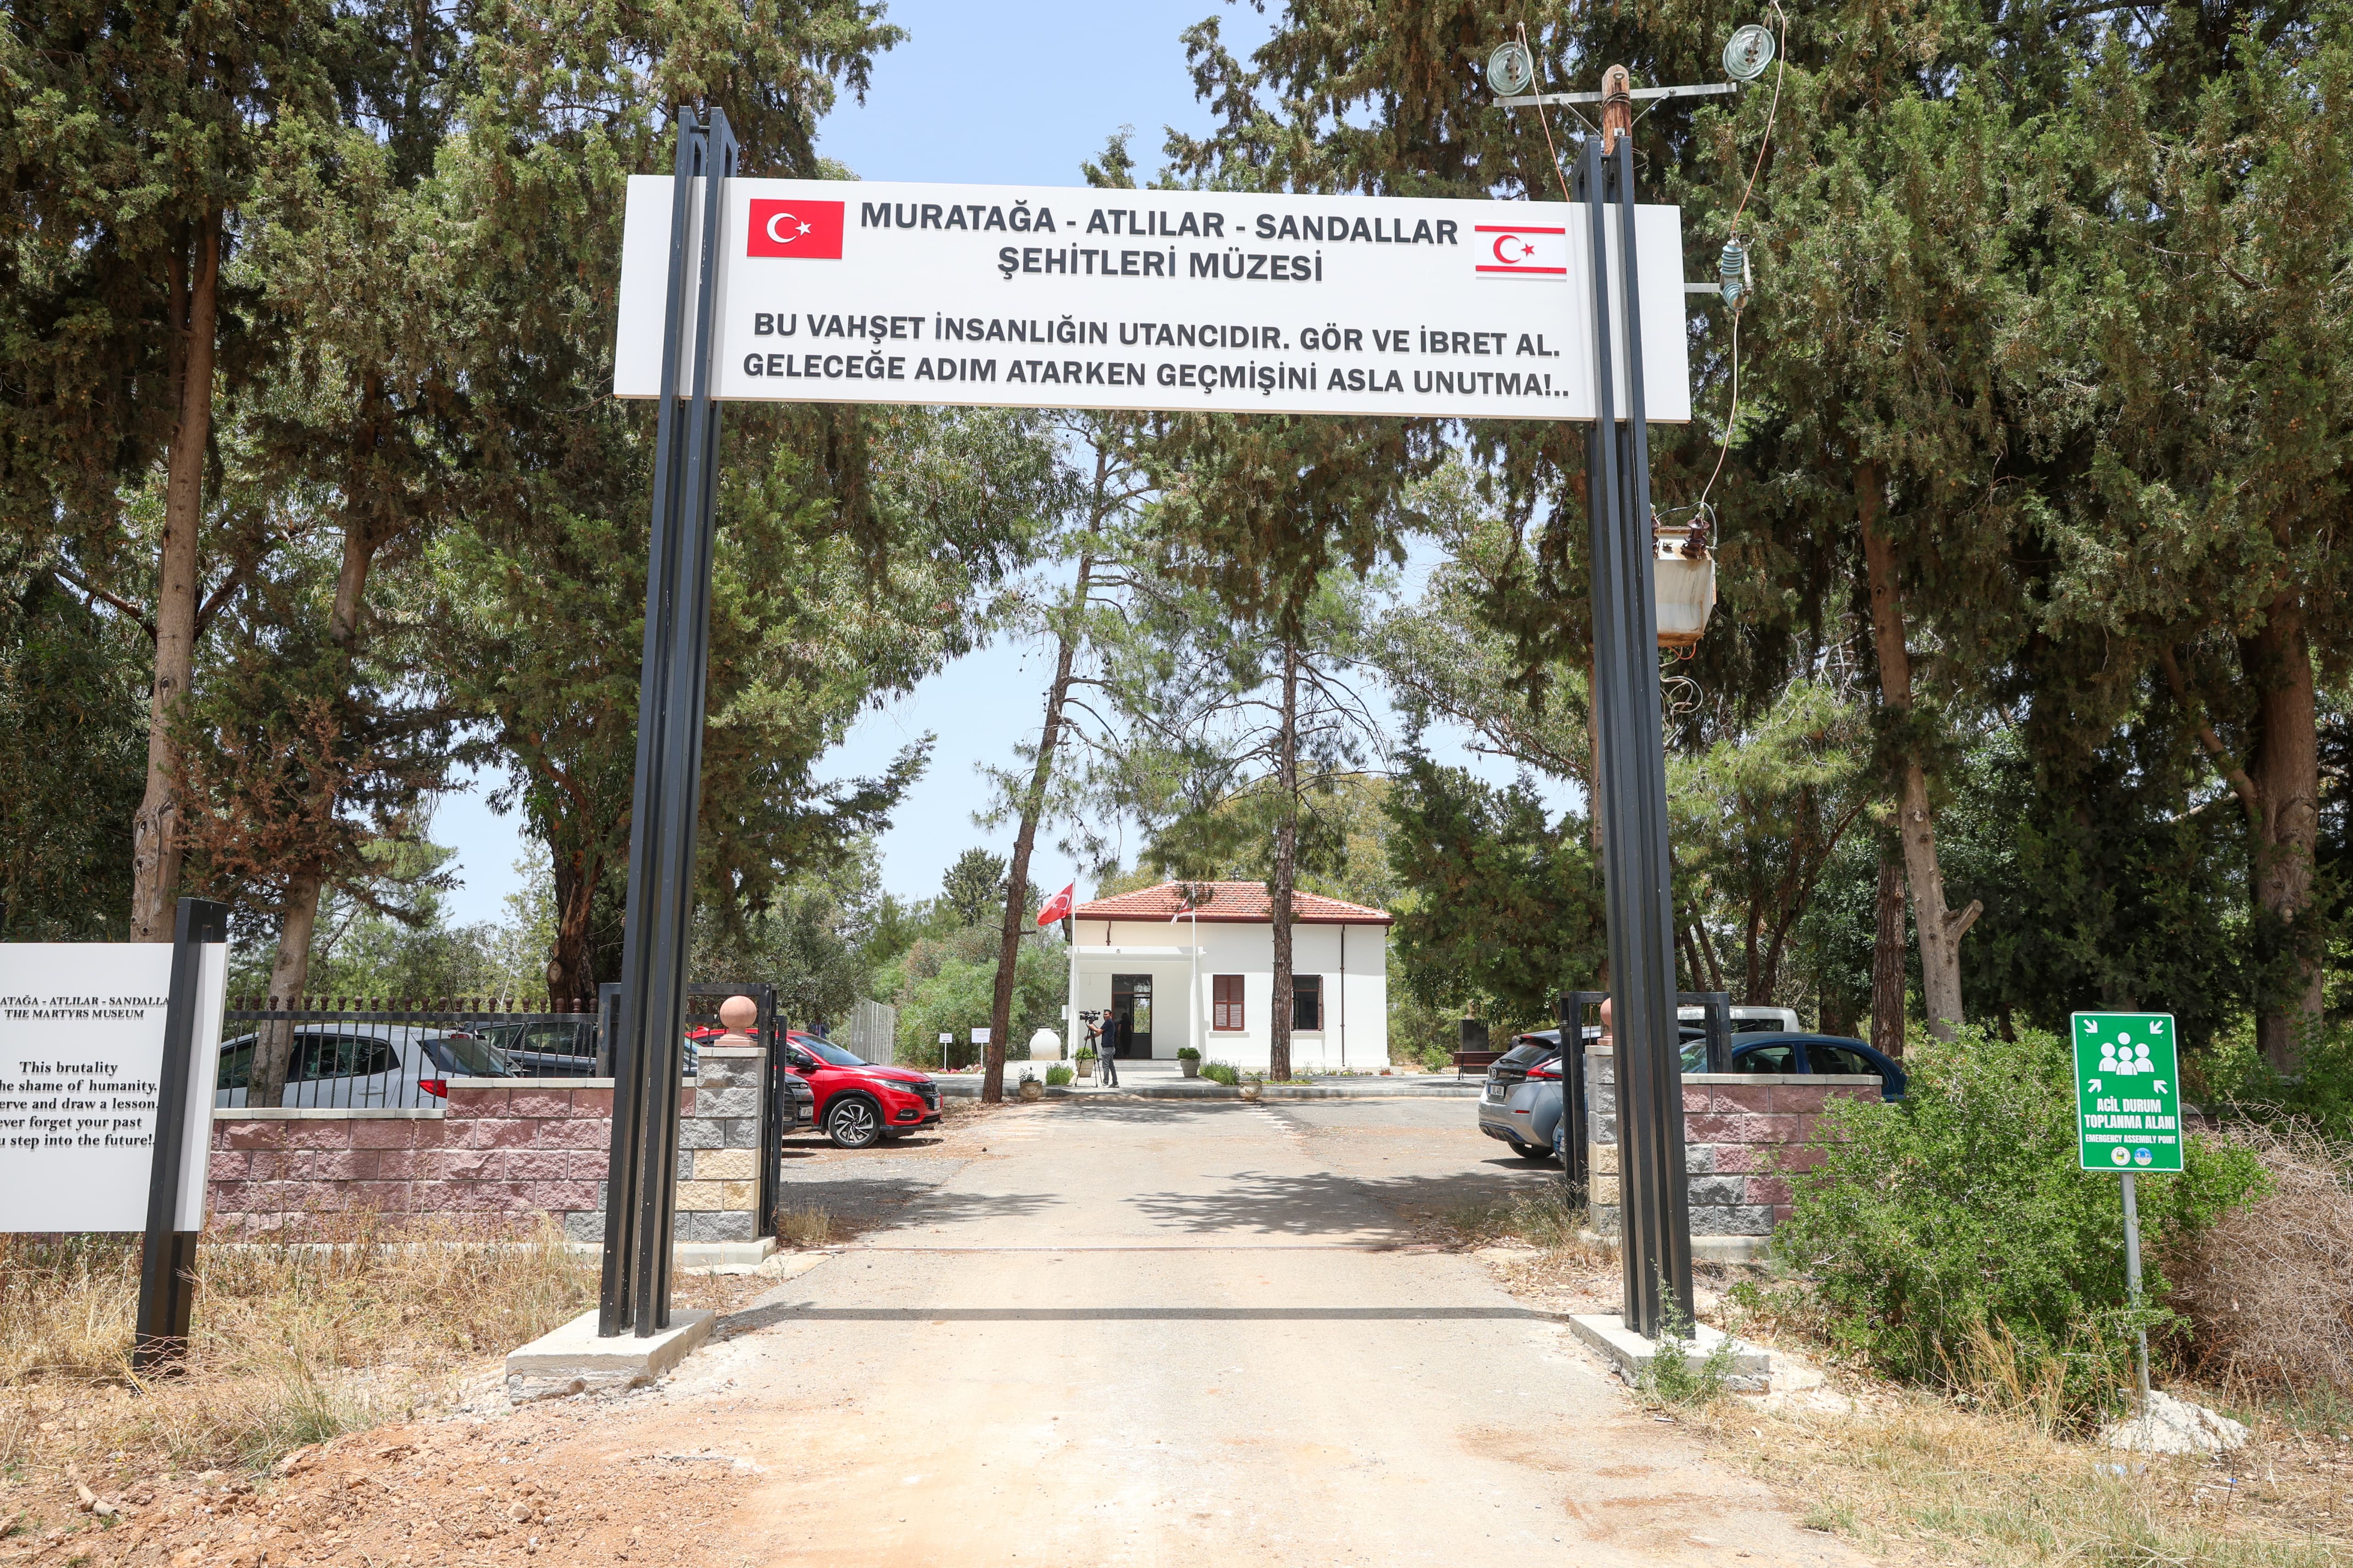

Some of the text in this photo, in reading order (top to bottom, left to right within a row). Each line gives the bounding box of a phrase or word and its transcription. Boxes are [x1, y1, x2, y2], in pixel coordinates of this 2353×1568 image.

[861, 199, 1056, 233] MURATAĞA
[1086, 209, 1224, 238] ATLILAR
[1256, 214, 1458, 245] SANDALLAR
[998, 242, 1322, 282] ŞEHİTLERİ MÜZESİ
[754, 311, 1560, 357] BU VAHŞET İNSANLIĞIN UTANCIDIR. GÖR VE İBRET AL.
[744, 350, 1569, 397] GELECEĞE ADIM ATARKEN GEÇMİŞİNİ ASLA UNUTMA!..
[0, 995, 38, 1006] ATAĞA
[50, 997, 98, 1005] ATLILAR
[5, 1009, 144, 1018] THE MARTYRS MUSEUM
[20, 1061, 118, 1076] This brutality
[19, 1079, 63, 1091] shame
[68, 1079, 84, 1091] of
[89, 1079, 157, 1095] humanity.
[32, 1097, 57, 1109] and
[62, 1097, 96, 1109] draw
[2097, 1095, 2162, 1113] ACİL DURUM
[30, 1115, 73, 1131] forget
[76, 1119, 109, 1131] your
[113, 1117, 142, 1131] past
[2084, 1114, 2176, 1130] TOPLANMA ALANI
[10, 1136, 40, 1149] step
[44, 1134, 72, 1146] into
[78, 1134, 100, 1146] the
[2085, 1134, 2176, 1144] EMERGENCY ASSEMBLY POINT
